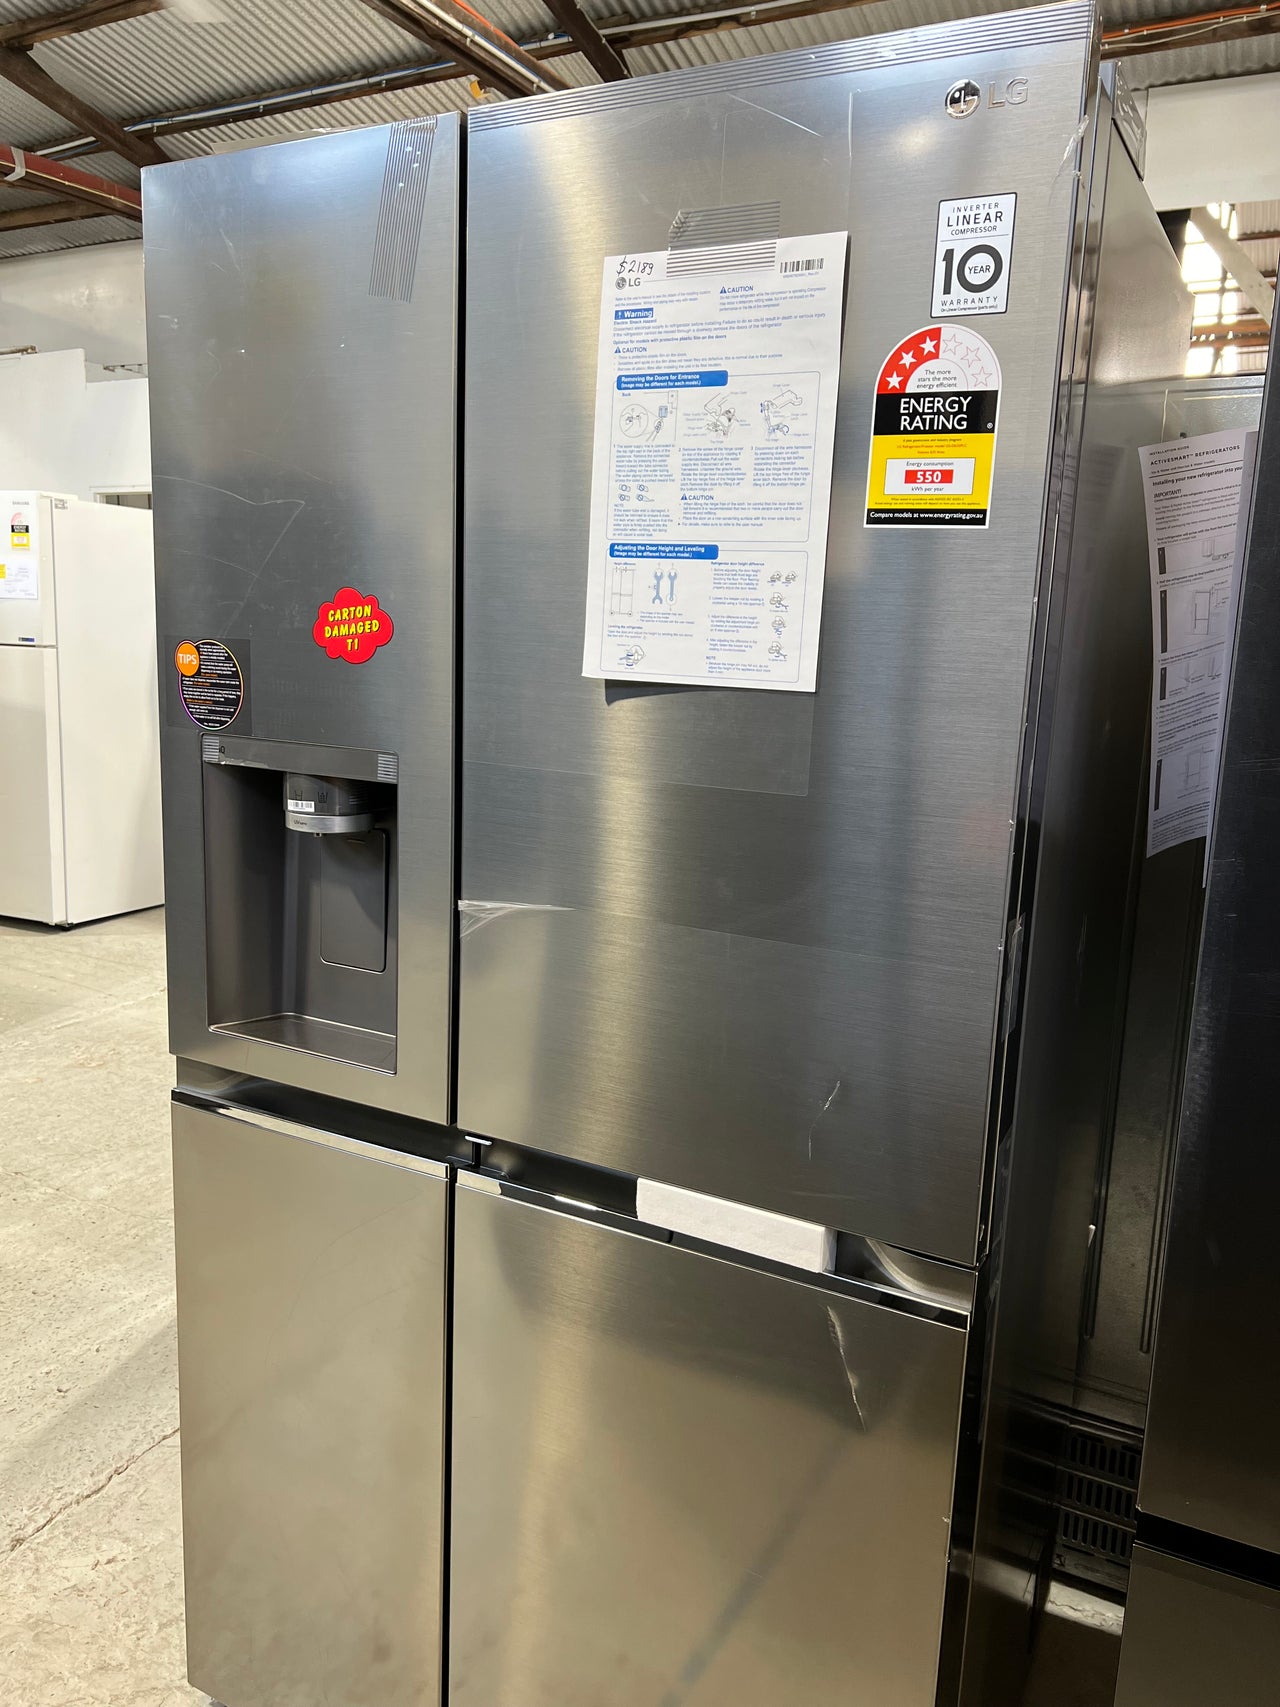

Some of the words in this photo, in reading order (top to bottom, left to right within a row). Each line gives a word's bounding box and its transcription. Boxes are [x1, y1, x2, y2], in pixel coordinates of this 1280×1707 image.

[987, 77, 1028, 109] LG
[952, 202, 1000, 213] INVERTER
[947, 211, 1004, 227] LINEAR
[950, 225, 998, 236] COMPRESSOR
[616, 256, 654, 276] $2189
[942, 244, 1004, 296] 10
[968, 265, 991, 275] YEAR
[628, 278, 640, 287] LG
[728, 286, 754, 294] CAUTION
[941, 296, 998, 306] WARRANTY
[624, 309, 653, 318] Warning
[900, 396, 972, 413] ENERGY
[900, 414, 968, 430] RATING
[1149, 447, 1177, 456] INSTALLATION
[1195, 445, 1240, 457] REFRIGERATORS
[916, 471, 942, 483] 550
[1152, 478, 1174, 486] Installing
[1198, 469, 1224, 478] refrigerator
[1154, 489, 1182, 498] IMPORTANT!
[328, 605, 371, 622] CARTON
[324, 620, 379, 638] DAMAGED
[178, 654, 197, 664] TIPS
